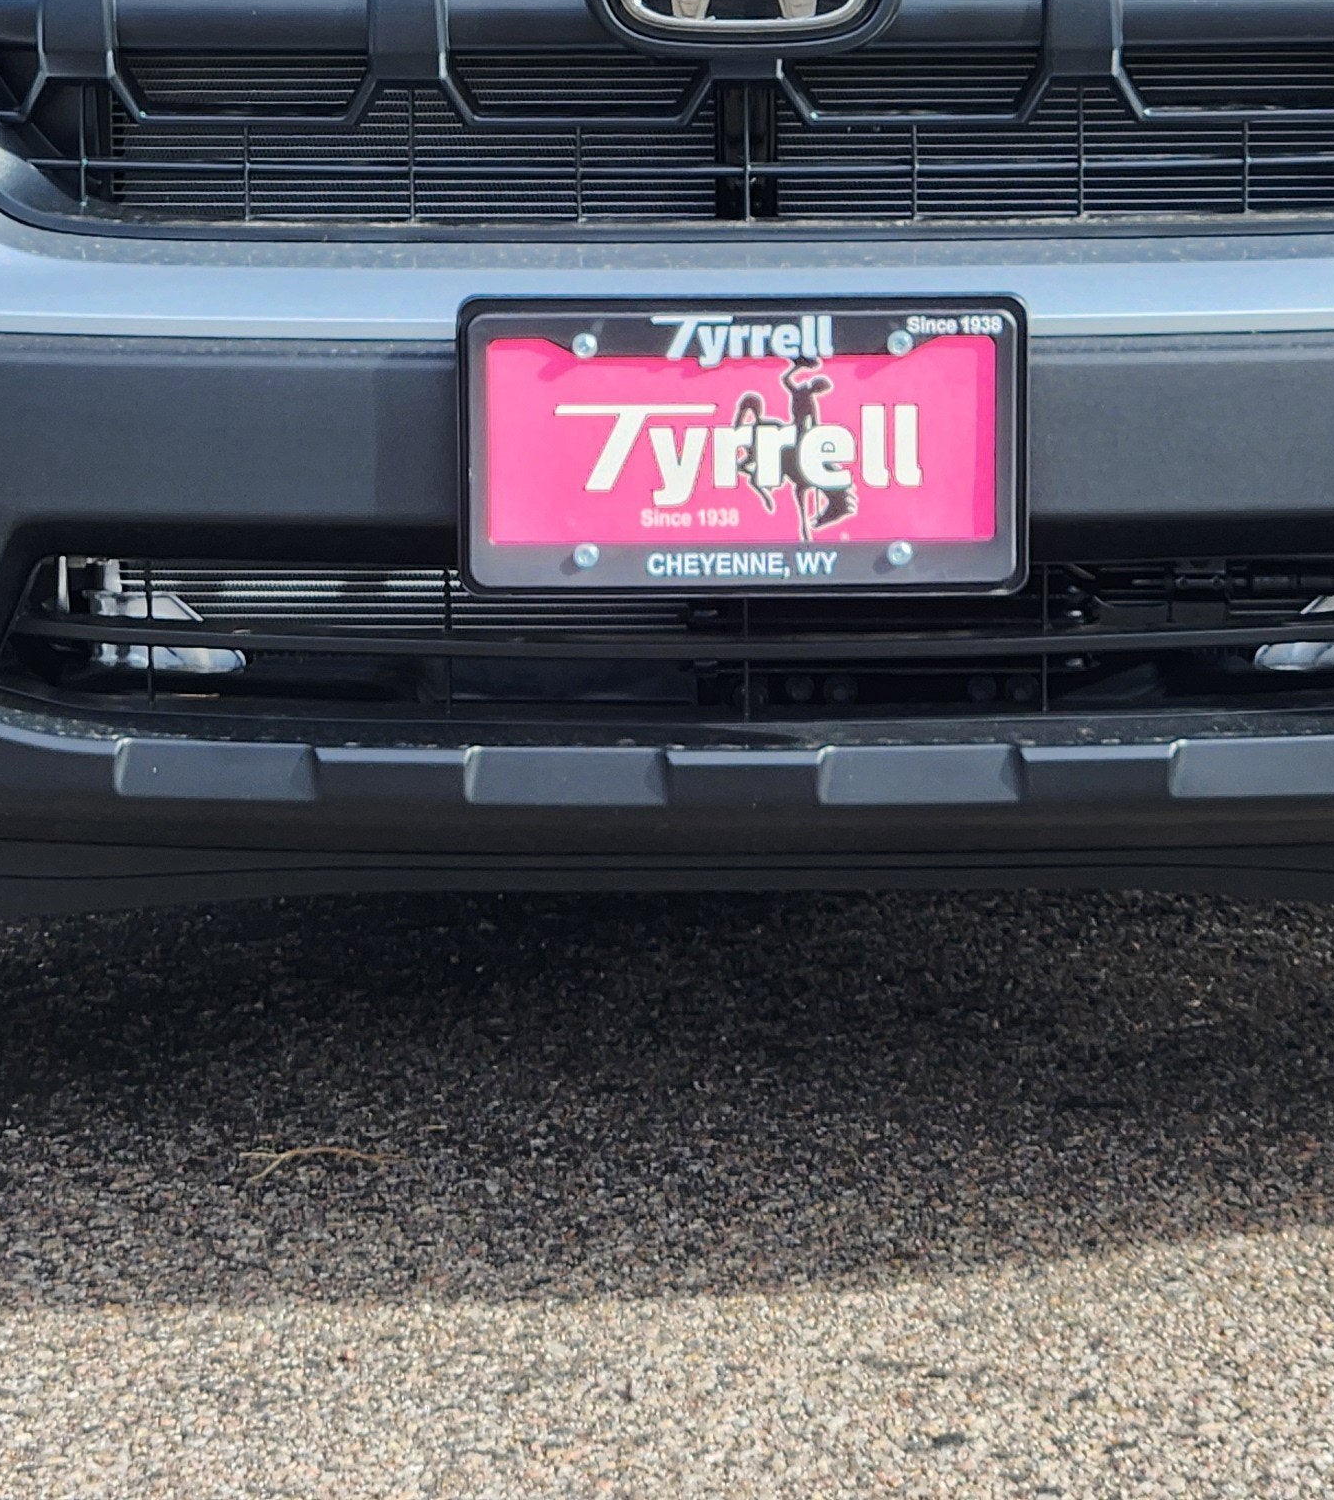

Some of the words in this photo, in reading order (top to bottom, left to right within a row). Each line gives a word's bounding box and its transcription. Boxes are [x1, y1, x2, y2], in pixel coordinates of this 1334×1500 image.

[906, 315, 957, 334] Since
[960, 315, 1003, 334] 1938
[650, 314, 834, 368] Tyrrell
[554, 403, 923, 507] Tyrrell
[640, 508, 692, 527] Since
[697, 508, 739, 527] 1938
[647, 552, 790, 578] CHEYENNE,
[795, 552, 837, 575] WY
